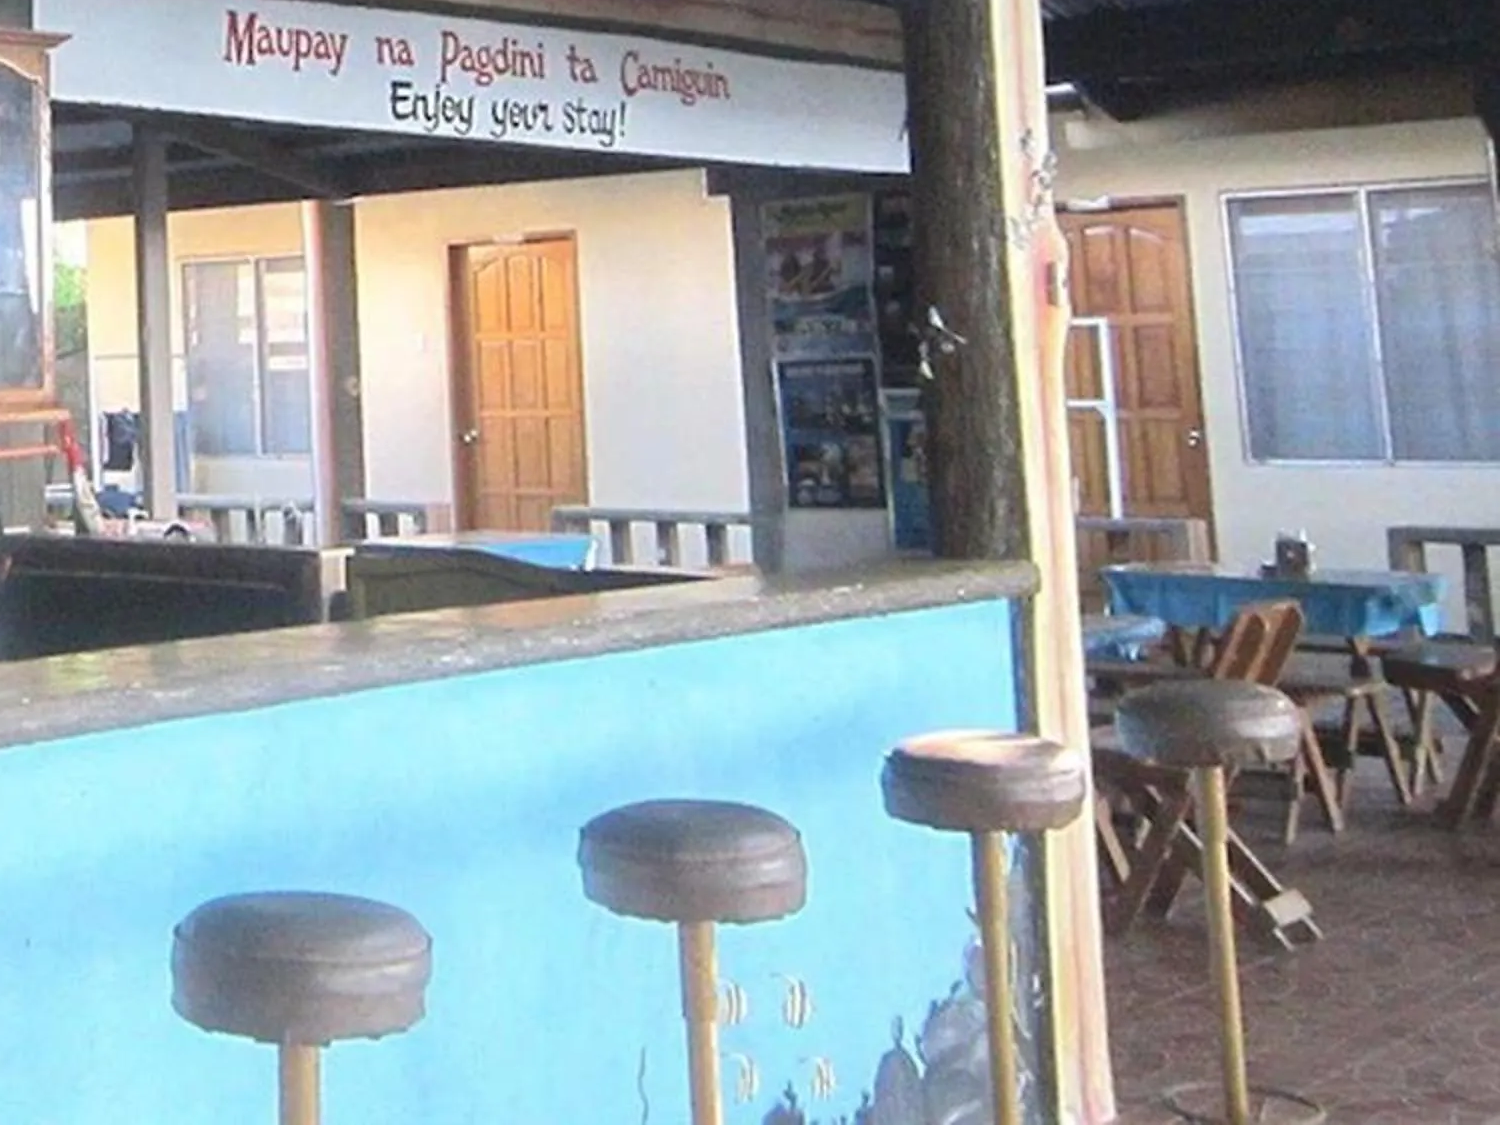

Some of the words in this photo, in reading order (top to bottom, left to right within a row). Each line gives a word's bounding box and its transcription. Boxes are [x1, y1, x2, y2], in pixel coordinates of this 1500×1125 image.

[223, 9, 348, 77] Maupay
[375, 36, 414, 67] na
[440, 30, 545, 87] Pagdini
[567, 44, 598, 84] ta
[619, 50, 731, 106] Camiguin
[389, 81, 475, 136] Enjoy
[490, 97, 554, 139] your
[563, 97, 627, 147] stay!
